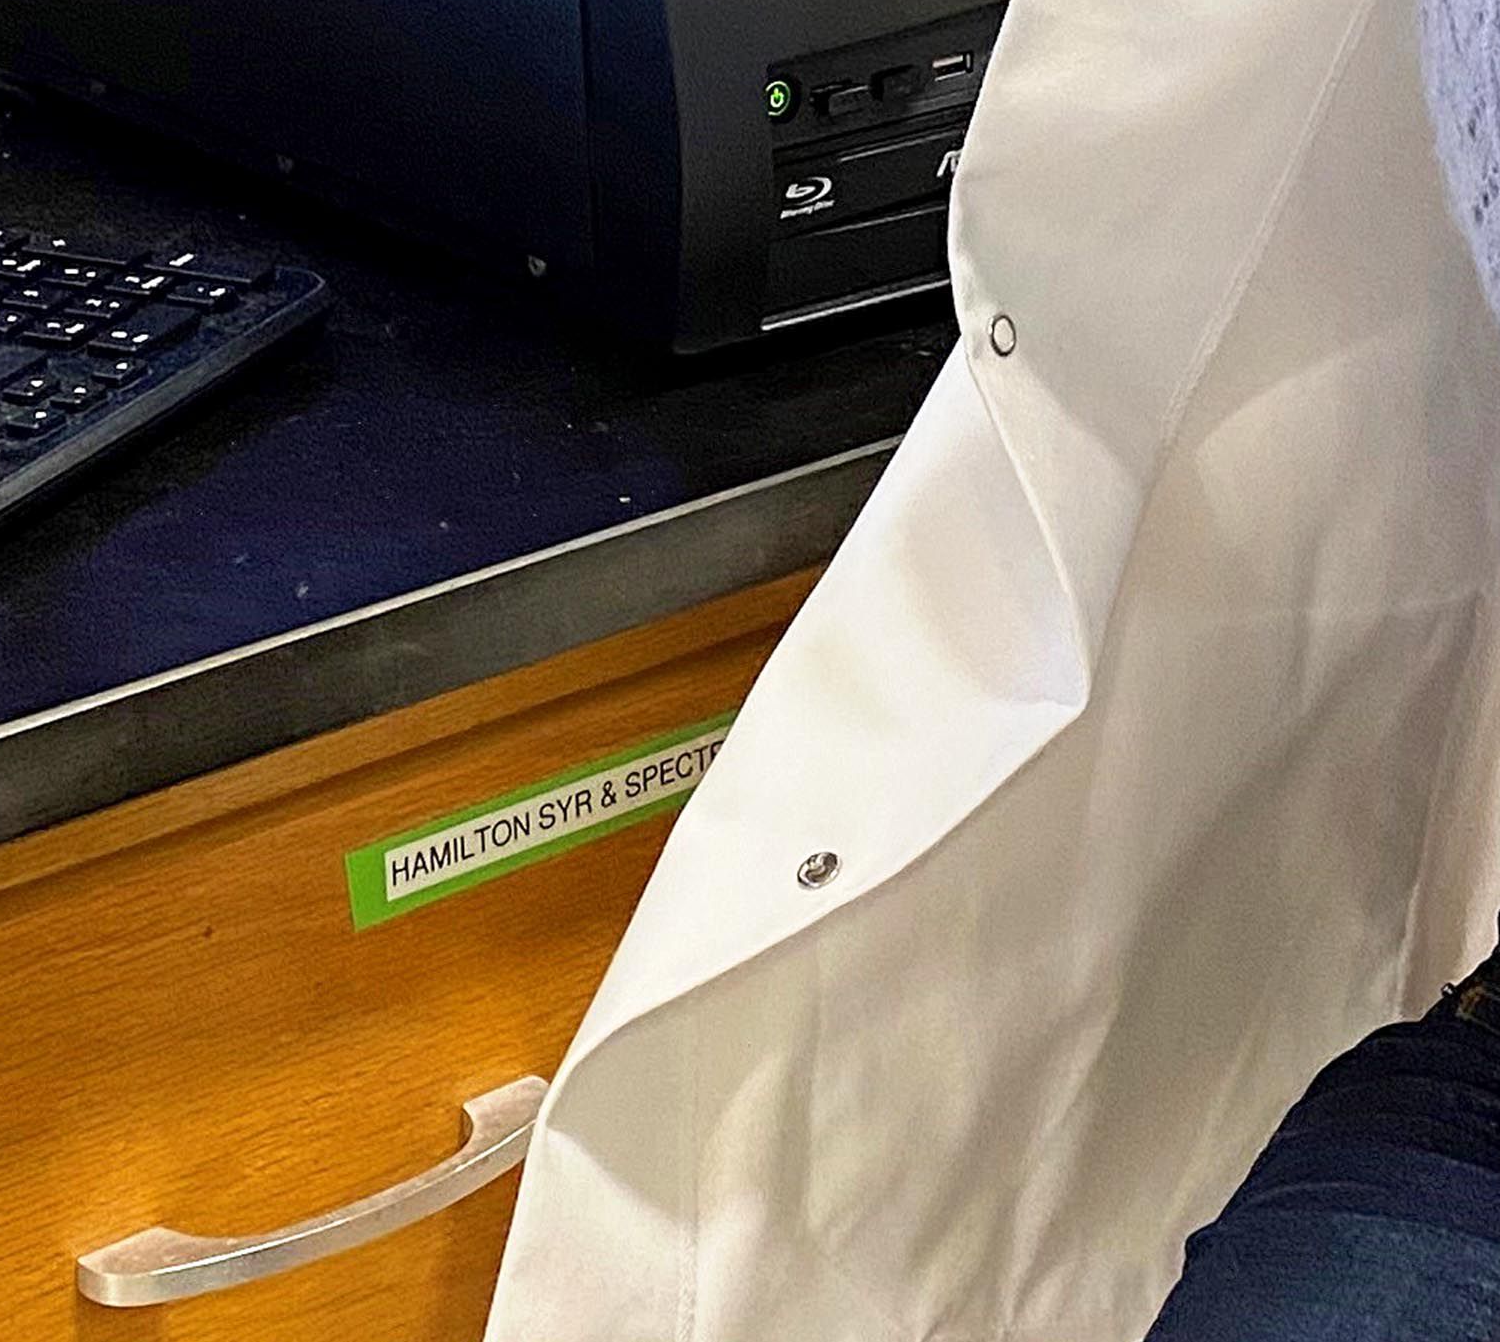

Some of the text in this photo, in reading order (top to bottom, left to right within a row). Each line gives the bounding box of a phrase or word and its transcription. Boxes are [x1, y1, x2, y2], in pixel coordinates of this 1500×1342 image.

[392, 811, 531, 887] HAMILTON
[539, 790, 593, 831] SYR
[600, 781, 618, 810] &
